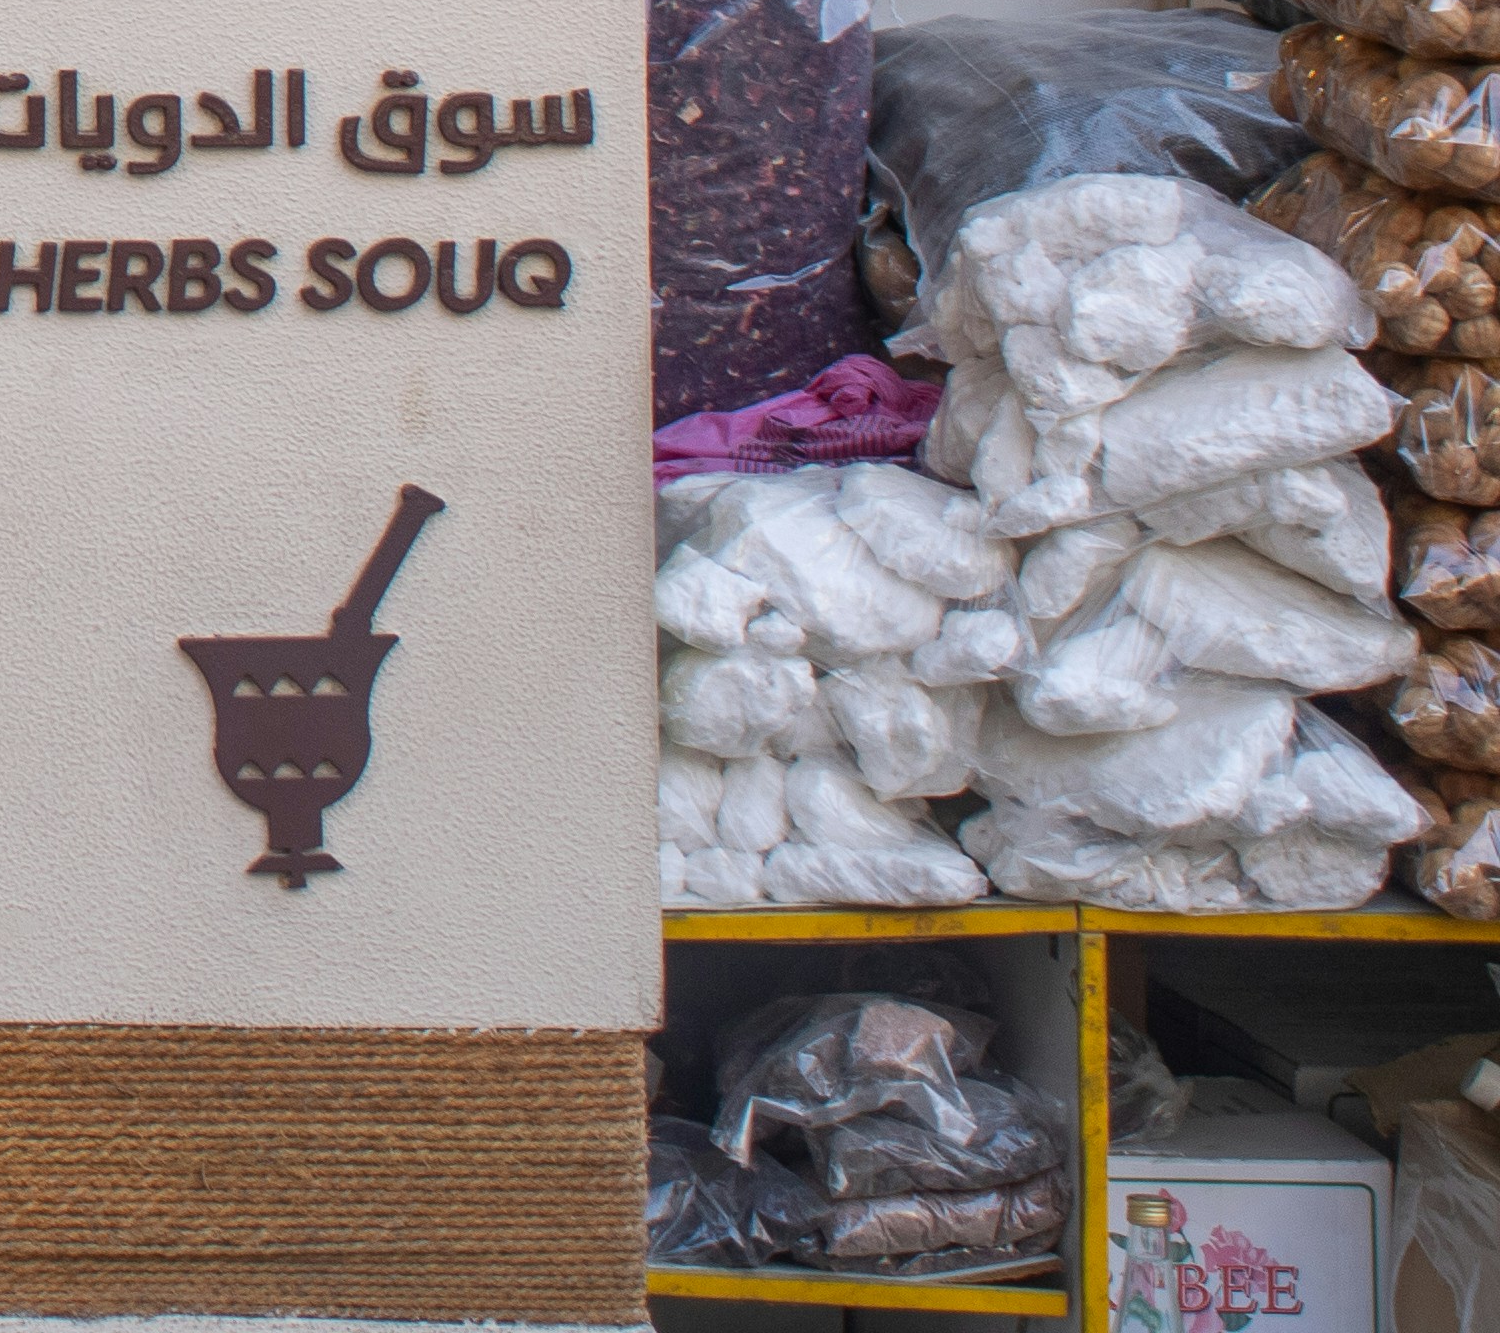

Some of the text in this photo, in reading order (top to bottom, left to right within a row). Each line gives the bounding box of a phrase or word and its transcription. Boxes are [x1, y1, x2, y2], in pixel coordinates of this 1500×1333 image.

[339, 68, 594, 175] سوق
[299, 236, 572, 315] SOUQ
[1109, 1264, 1304, 1314] BEE
